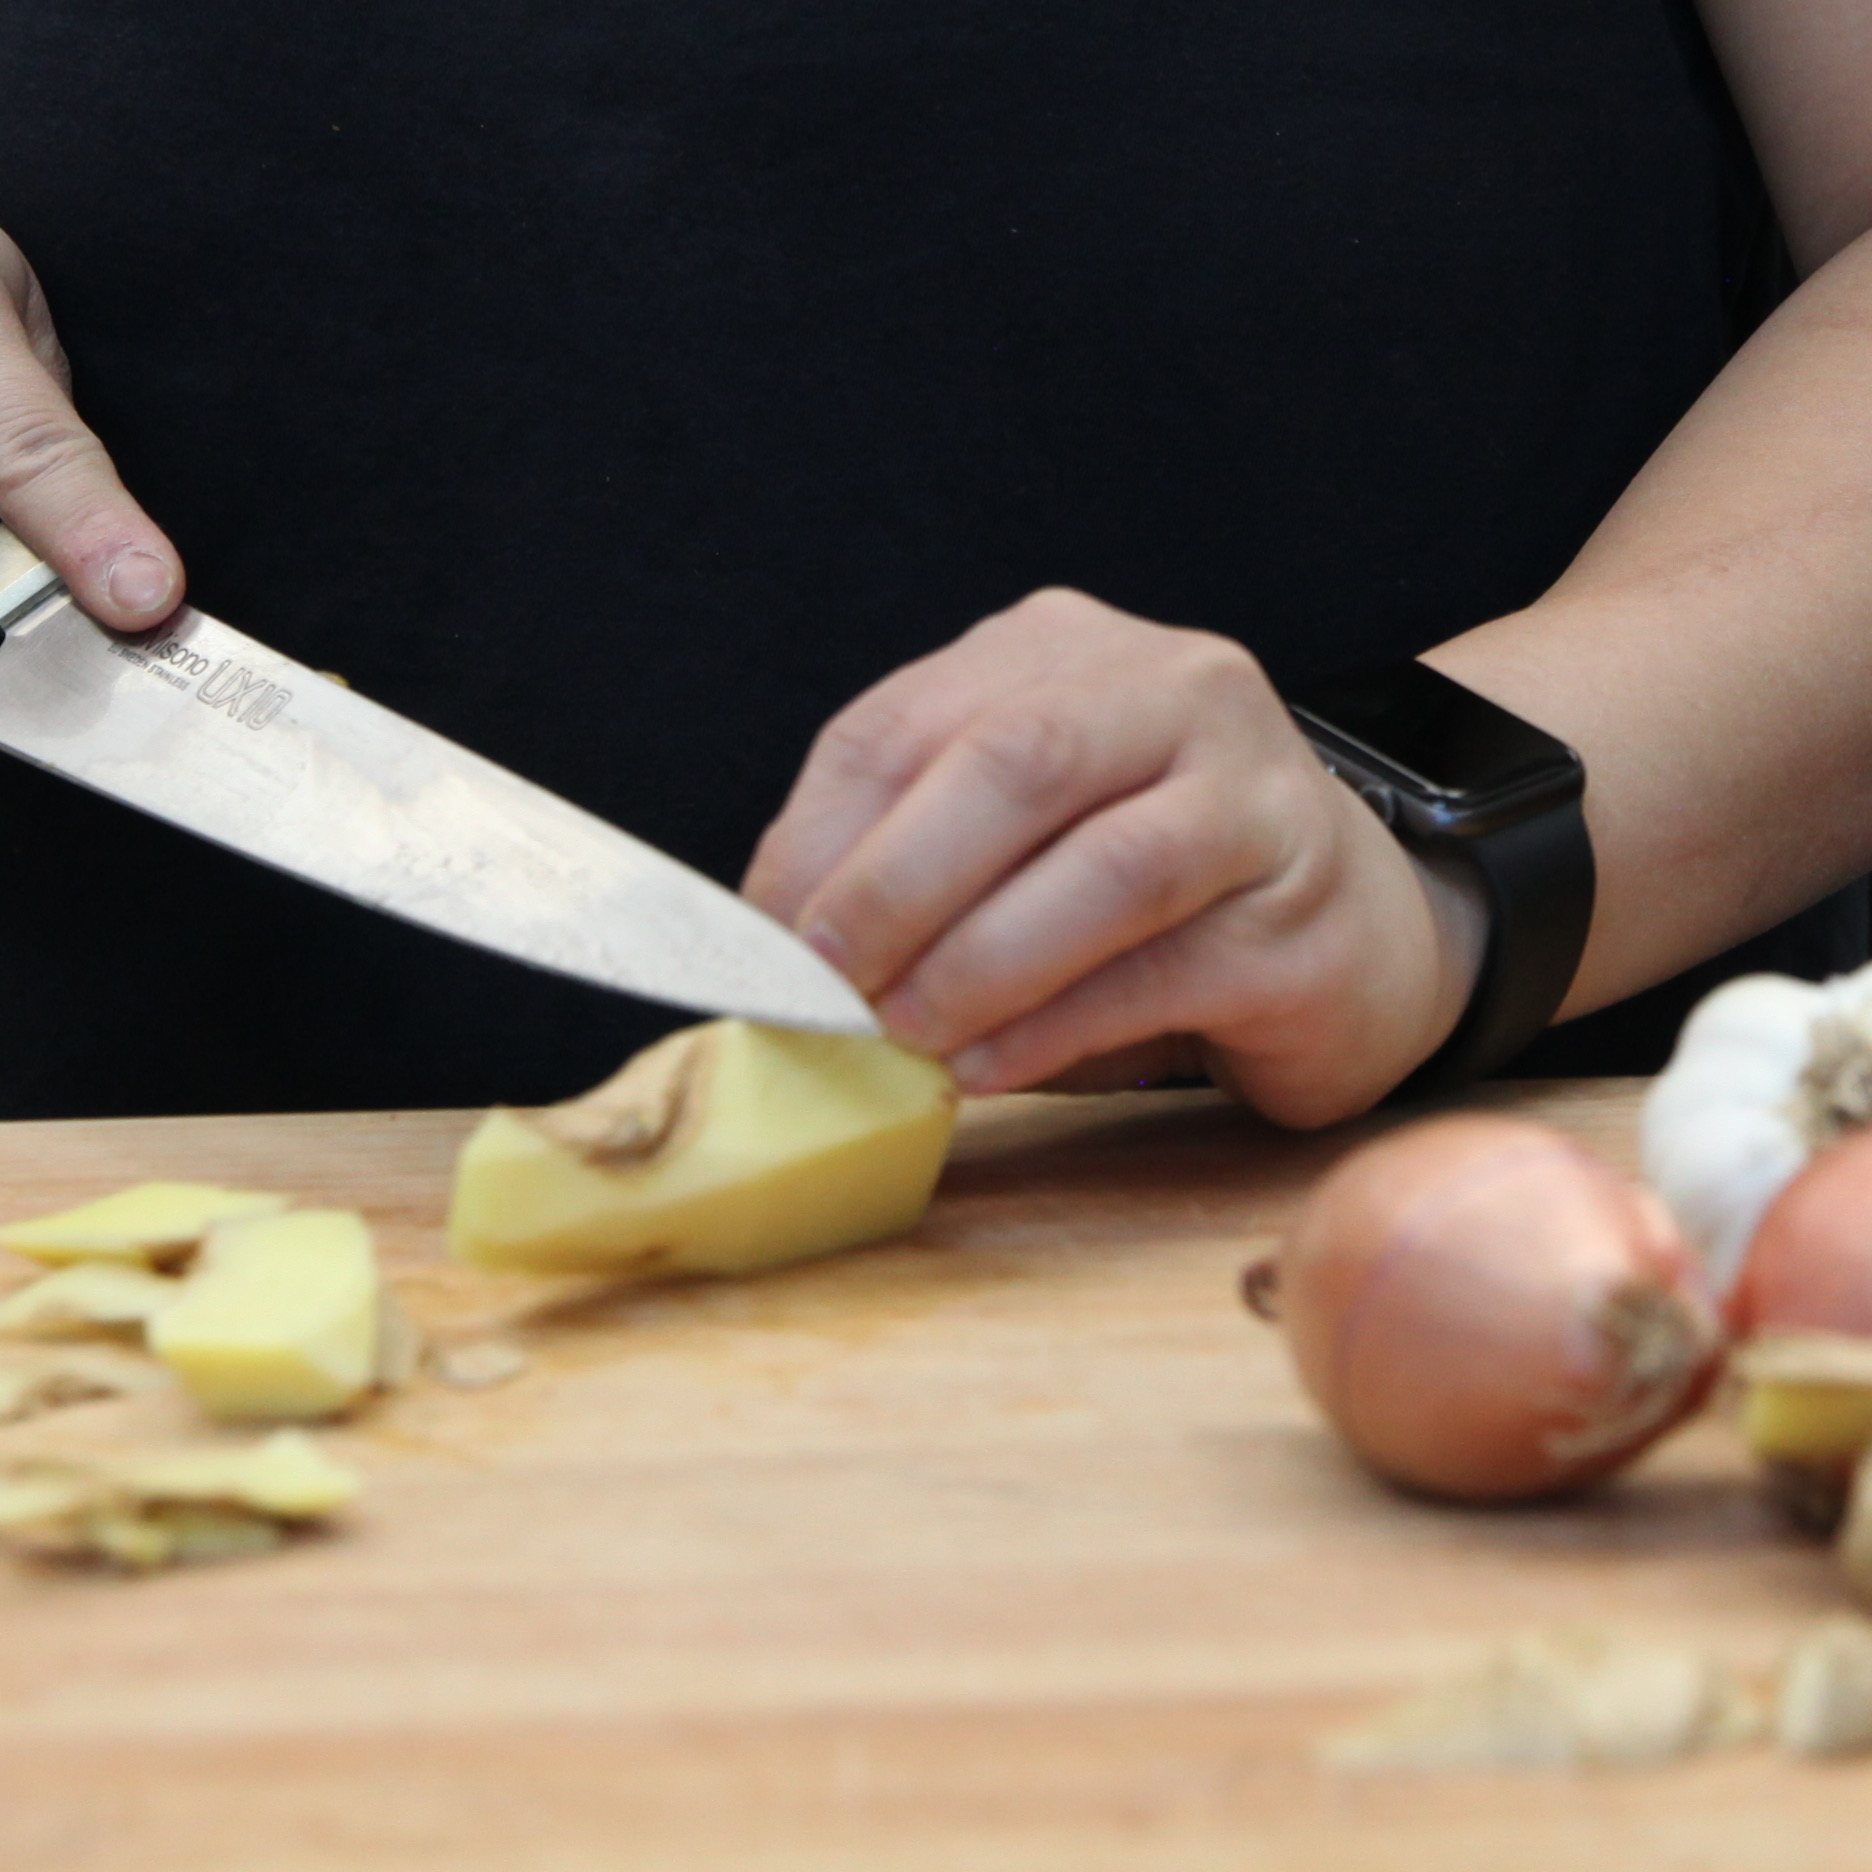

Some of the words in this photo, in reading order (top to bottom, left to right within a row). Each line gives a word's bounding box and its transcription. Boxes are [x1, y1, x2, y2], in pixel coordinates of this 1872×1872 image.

[118, 647, 150, 669] SWEDEN
[147, 664, 190, 691] STAINLESS
[196, 659, 293, 731] UX10
